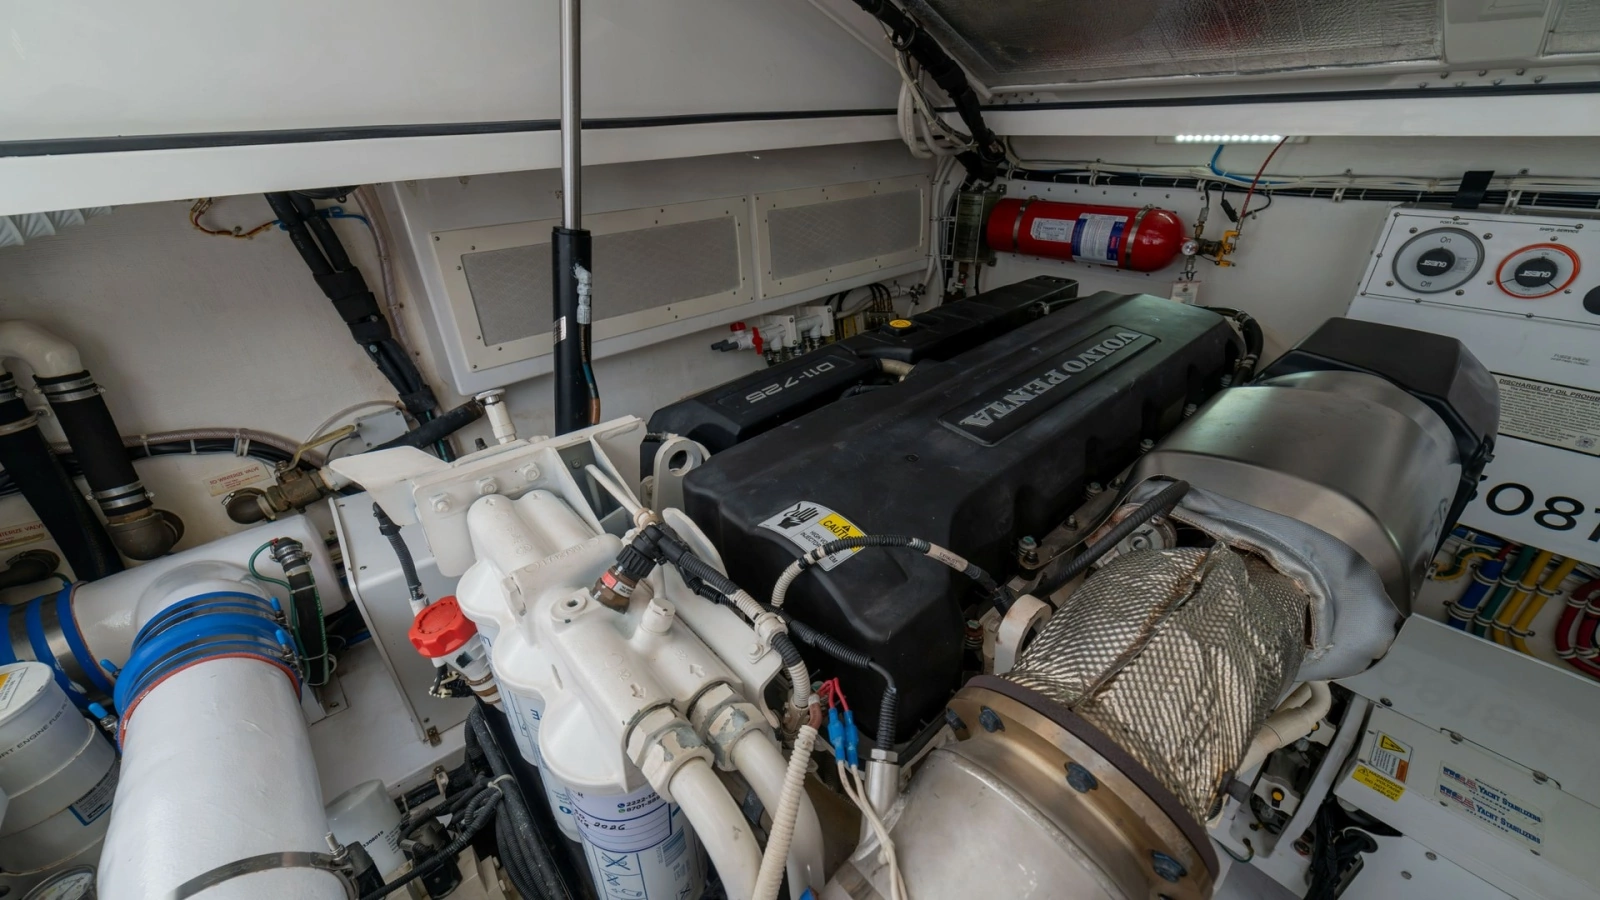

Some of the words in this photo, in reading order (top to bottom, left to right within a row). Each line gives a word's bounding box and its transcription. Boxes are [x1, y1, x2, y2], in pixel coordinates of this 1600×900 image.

[1440, 236, 1452, 244] On
[1420, 280, 1432, 288] Off
[1518, 269, 1551, 278] GUEST
[1061, 331, 1143, 374] VOLVO
[745, 361, 836, 404] D11-725
[1499, 378, 1541, 391] DISCHARGE
[1543, 384, 1555, 393] OF
[1555, 387, 1568, 397] OIL
[959, 368, 1072, 428] PENTA
[16, 724, 50, 749] ENGINE
[1368, 770, 1404, 791] HAZARDOUS
[1478, 785, 1501, 801] YACHT
[1502, 798, 1542, 823] STABILIZERS
[1476, 804, 1499, 821] YACHT
[1500, 817, 1541, 845] STABILIZERS
